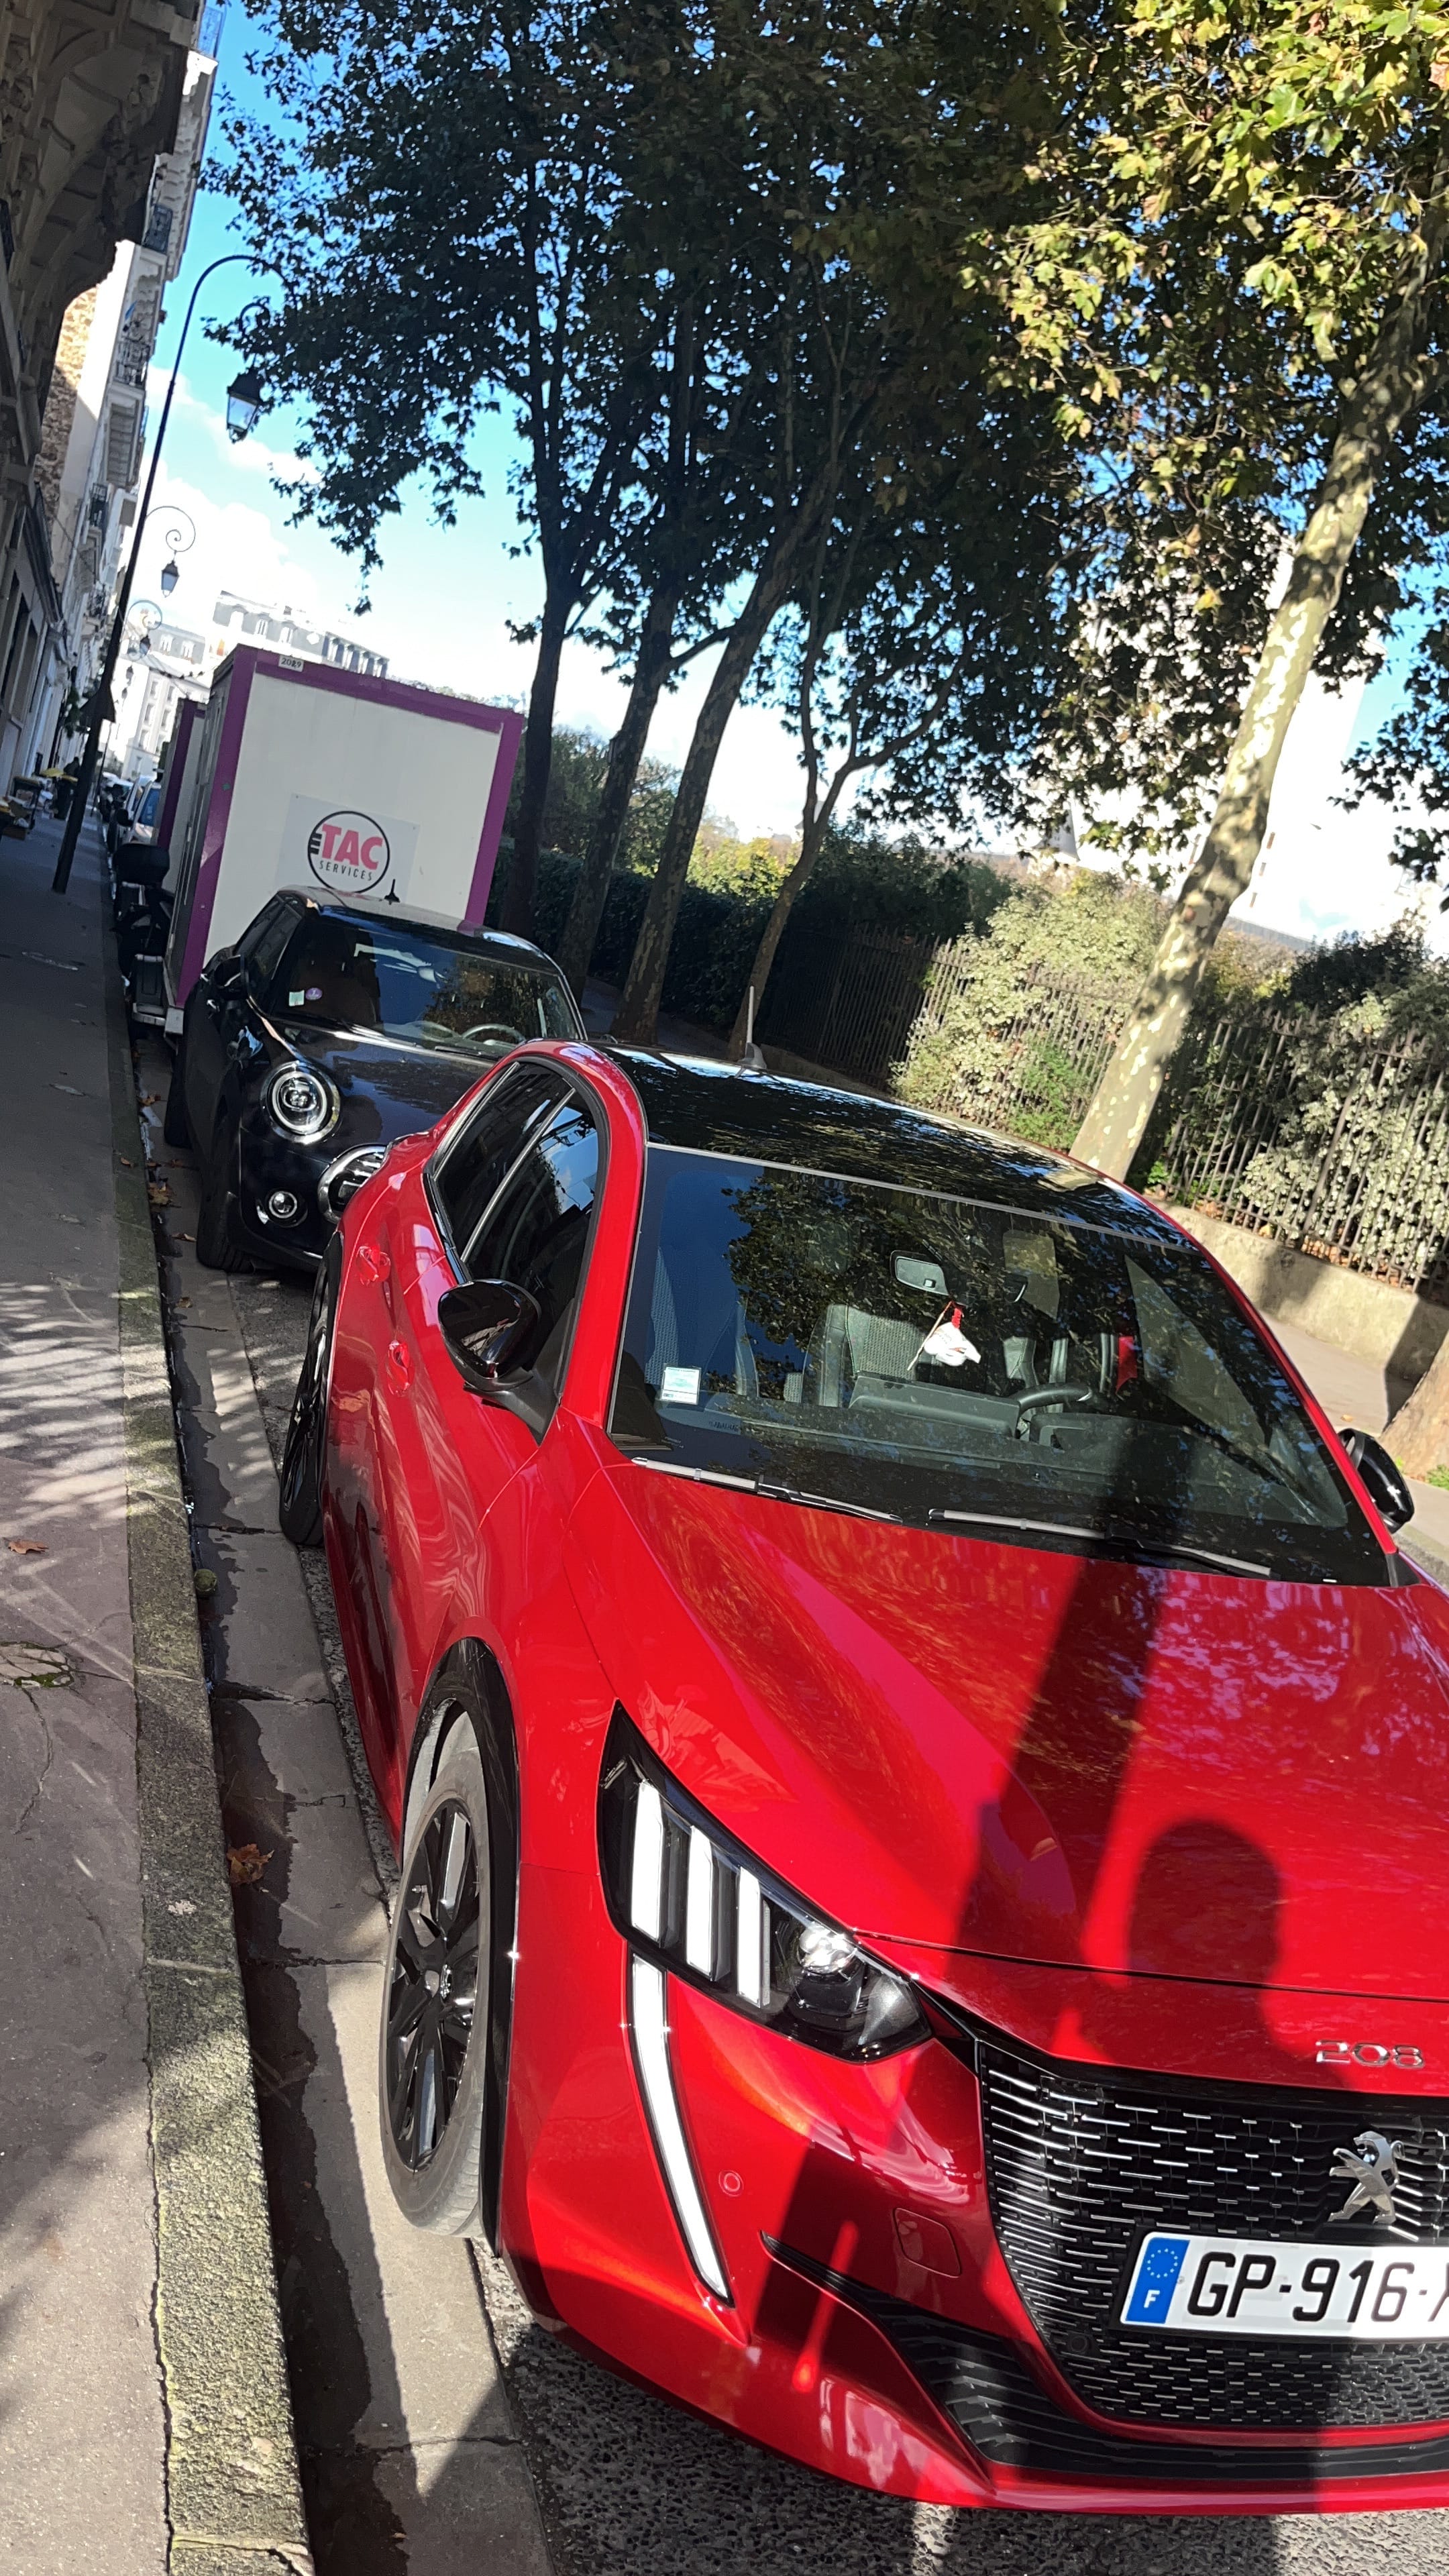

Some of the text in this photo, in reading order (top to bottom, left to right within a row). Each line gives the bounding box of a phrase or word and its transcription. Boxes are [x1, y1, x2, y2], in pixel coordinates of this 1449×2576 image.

[319, 860, 373, 881] SERVICES
[1316, 2039, 1425, 2069] 208
[1144, 2290, 1160, 2308] F
